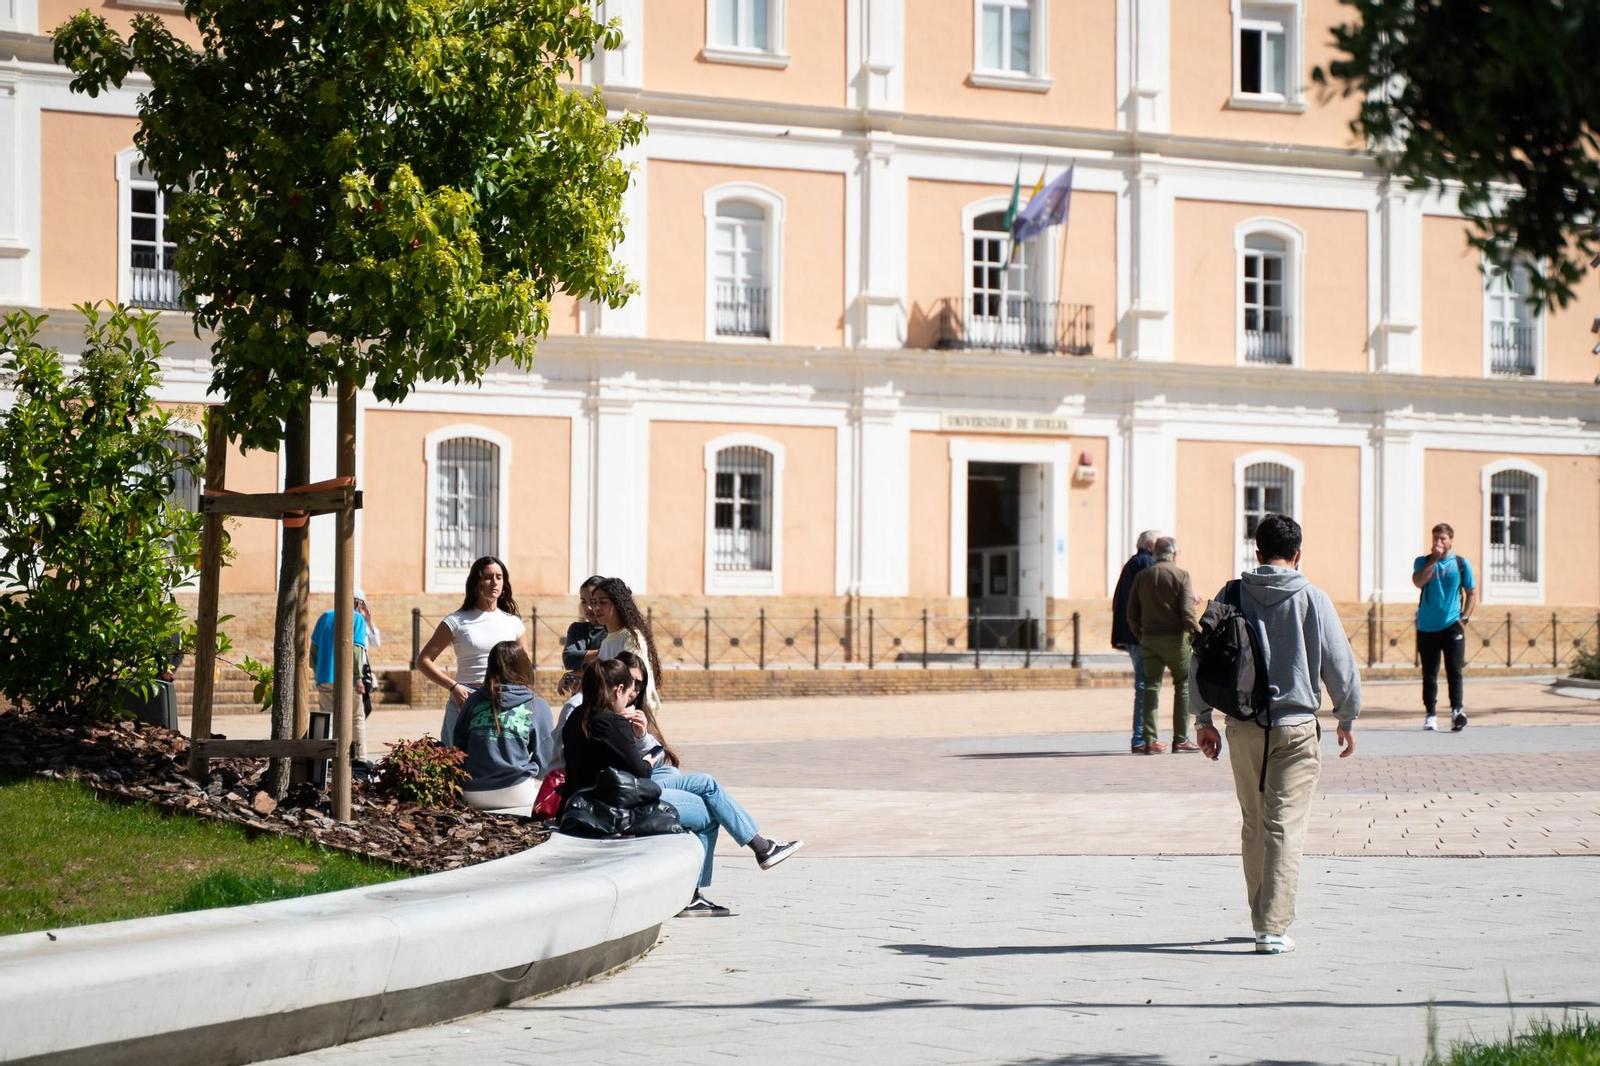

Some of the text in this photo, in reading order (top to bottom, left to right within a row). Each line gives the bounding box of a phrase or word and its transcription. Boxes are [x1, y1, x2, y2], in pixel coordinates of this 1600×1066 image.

[948, 416, 1068, 430] UNIVERSIDAD DE HUELVA
